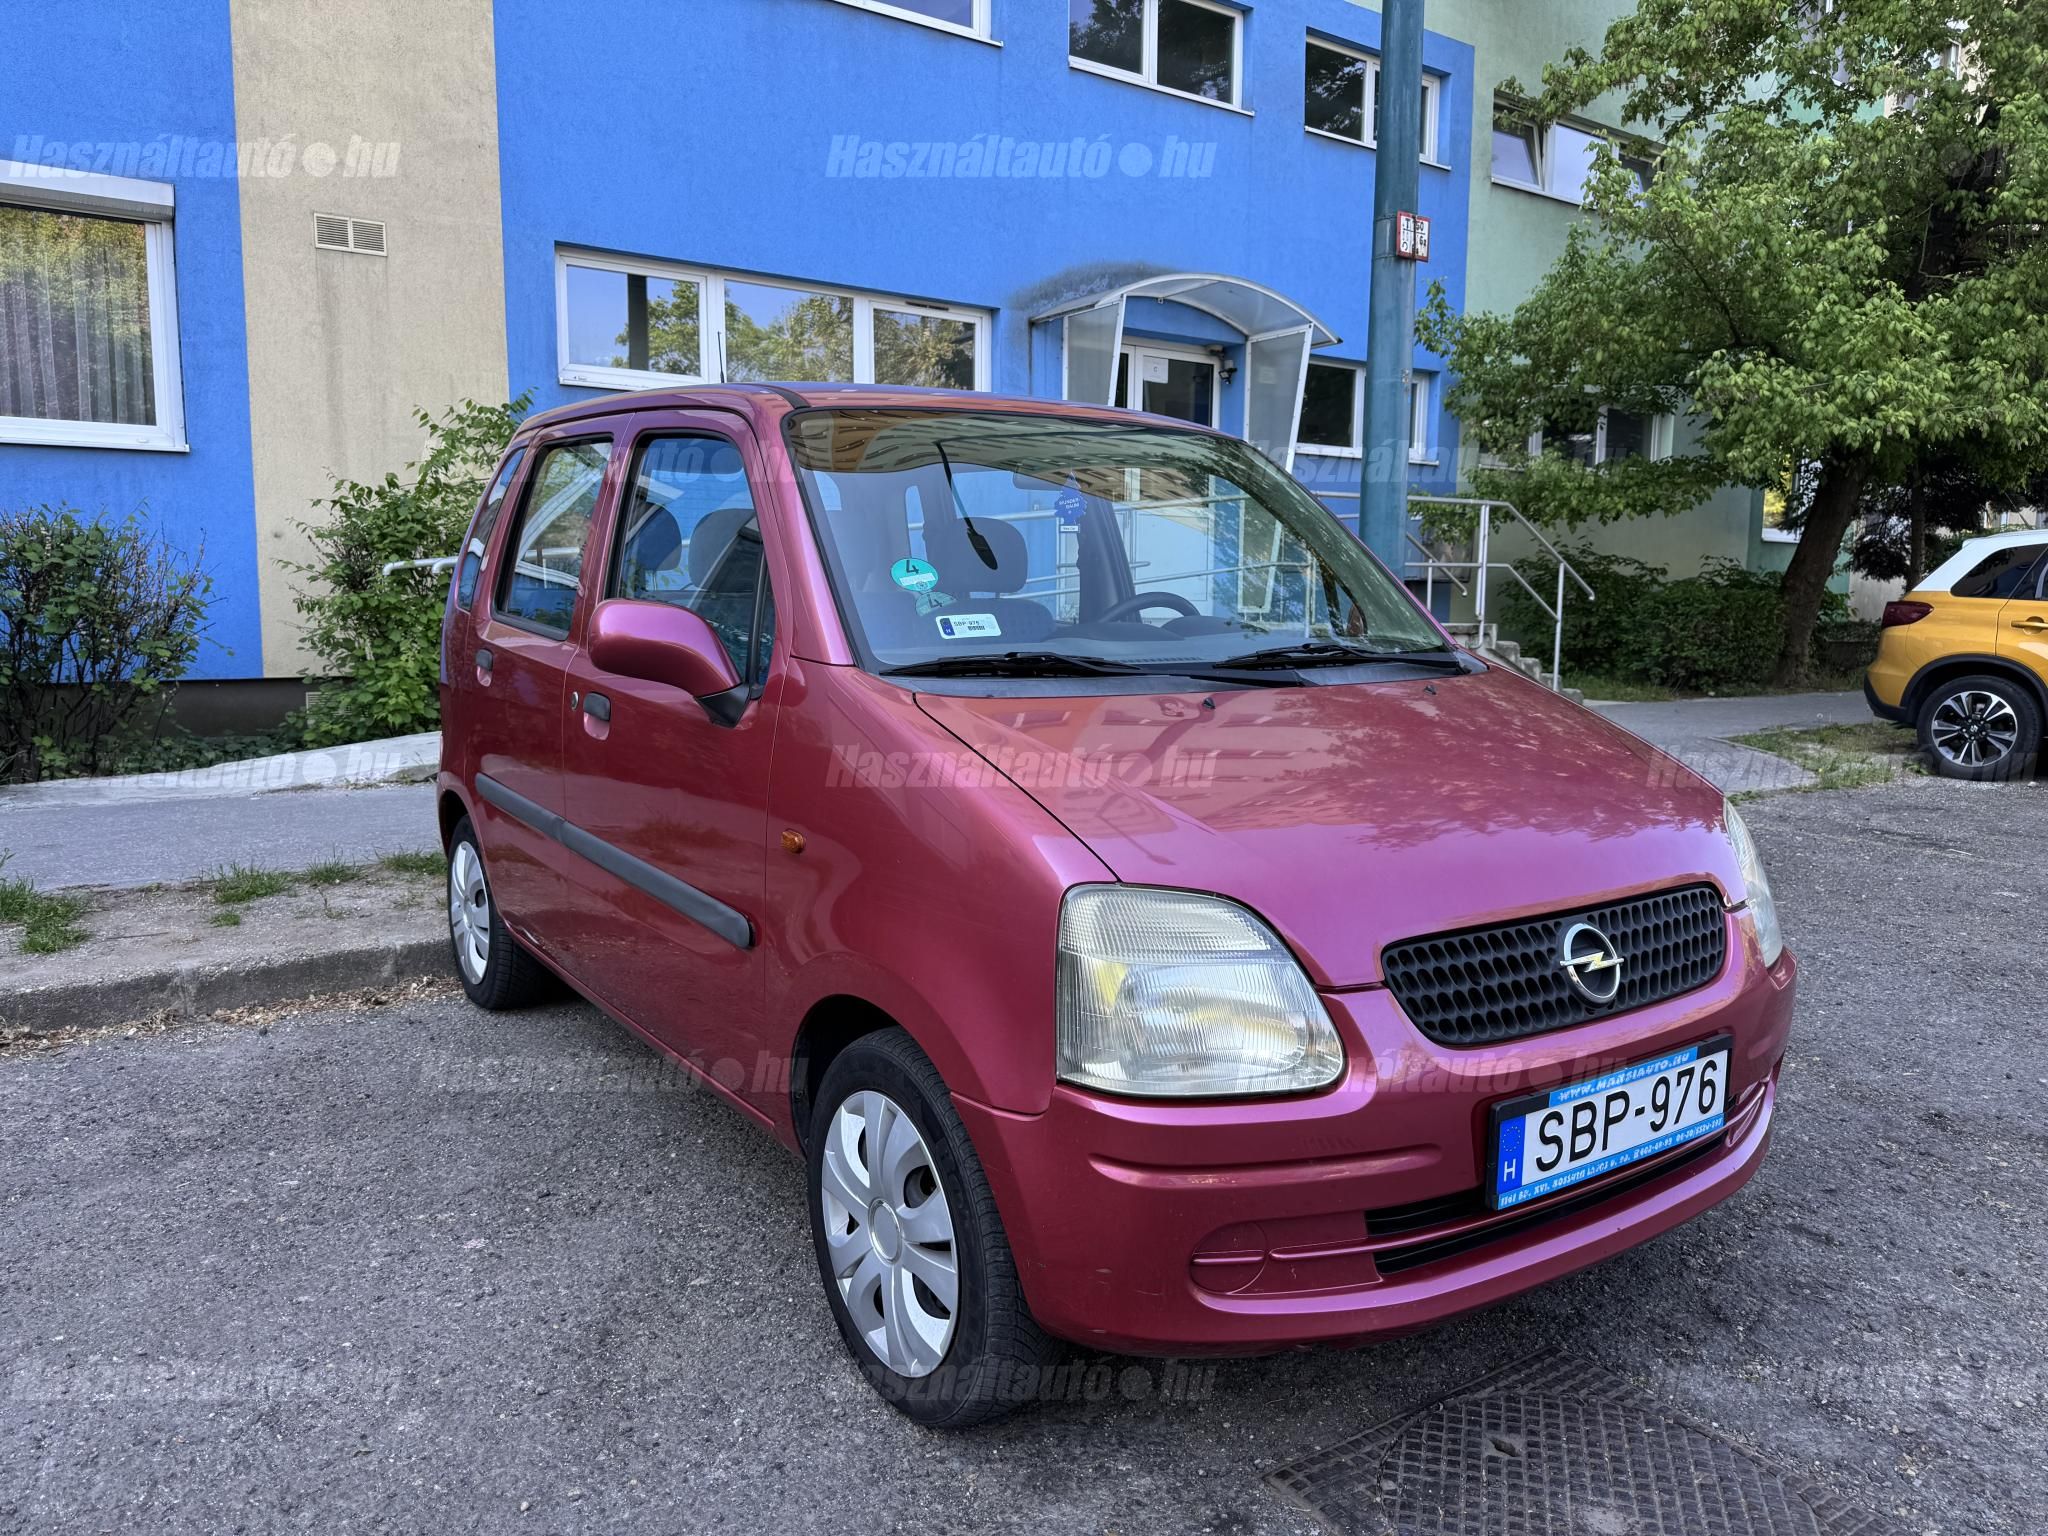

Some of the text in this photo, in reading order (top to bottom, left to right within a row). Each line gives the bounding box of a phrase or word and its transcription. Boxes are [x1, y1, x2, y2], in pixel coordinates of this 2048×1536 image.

[906, 559, 919, 574] 4
[1535, 1059, 1718, 1172] SBP-976
[1503, 1158, 1516, 1182] H
